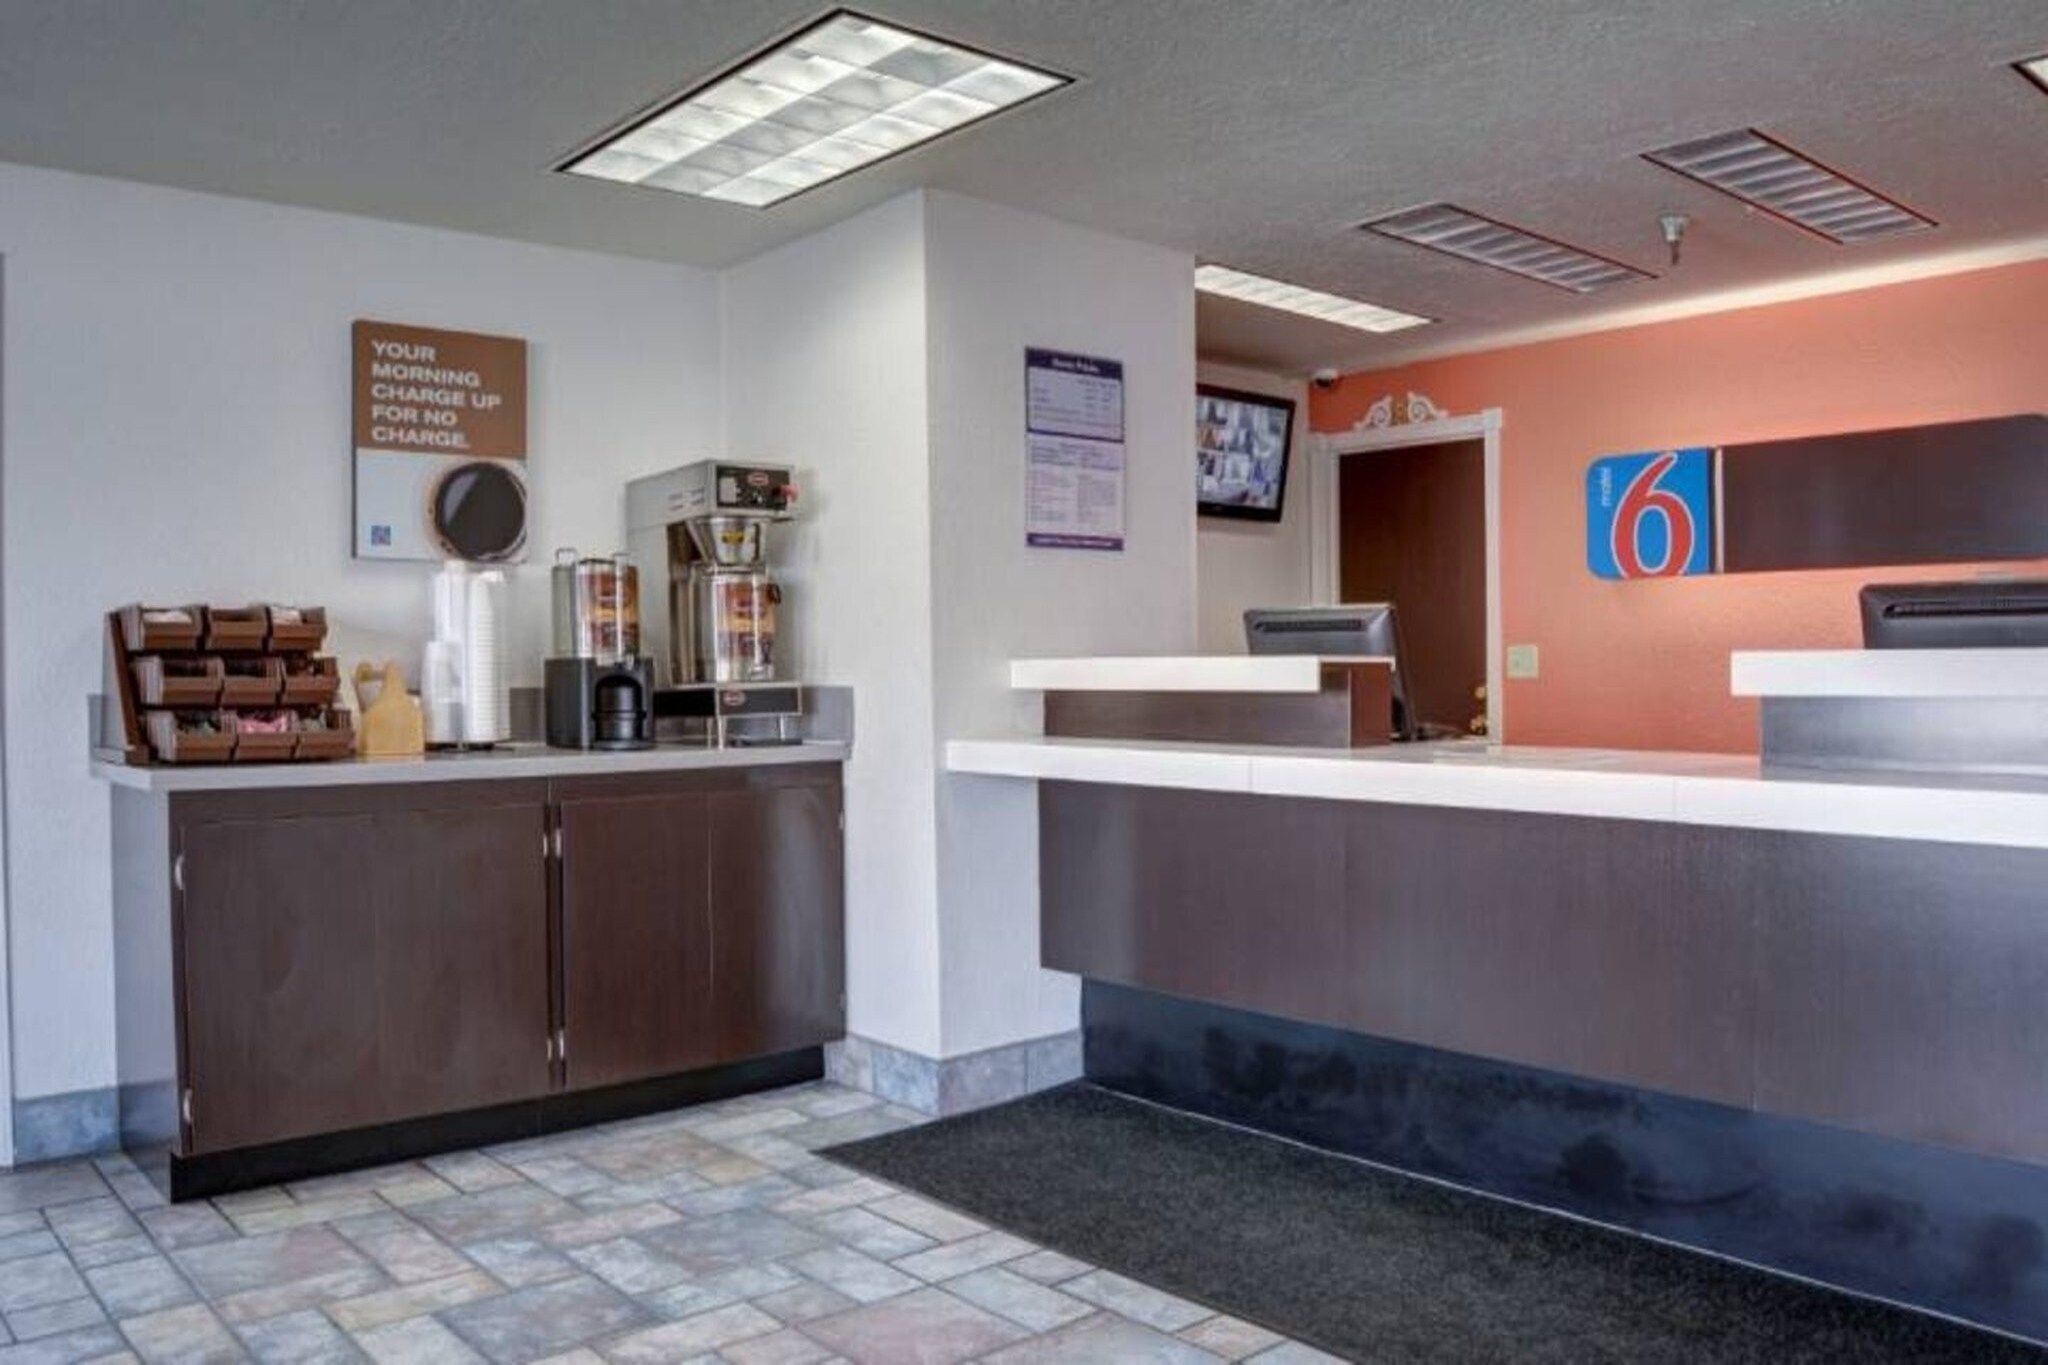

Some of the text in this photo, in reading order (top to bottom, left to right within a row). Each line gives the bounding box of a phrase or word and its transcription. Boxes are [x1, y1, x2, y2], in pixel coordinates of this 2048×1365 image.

[371, 341, 436, 361] YOUR
[371, 363, 480, 387] MORNING
[371, 384, 502, 410] CHARGE UP
[371, 405, 459, 426] FOR NO
[1610, 452, 1696, 580] 6
